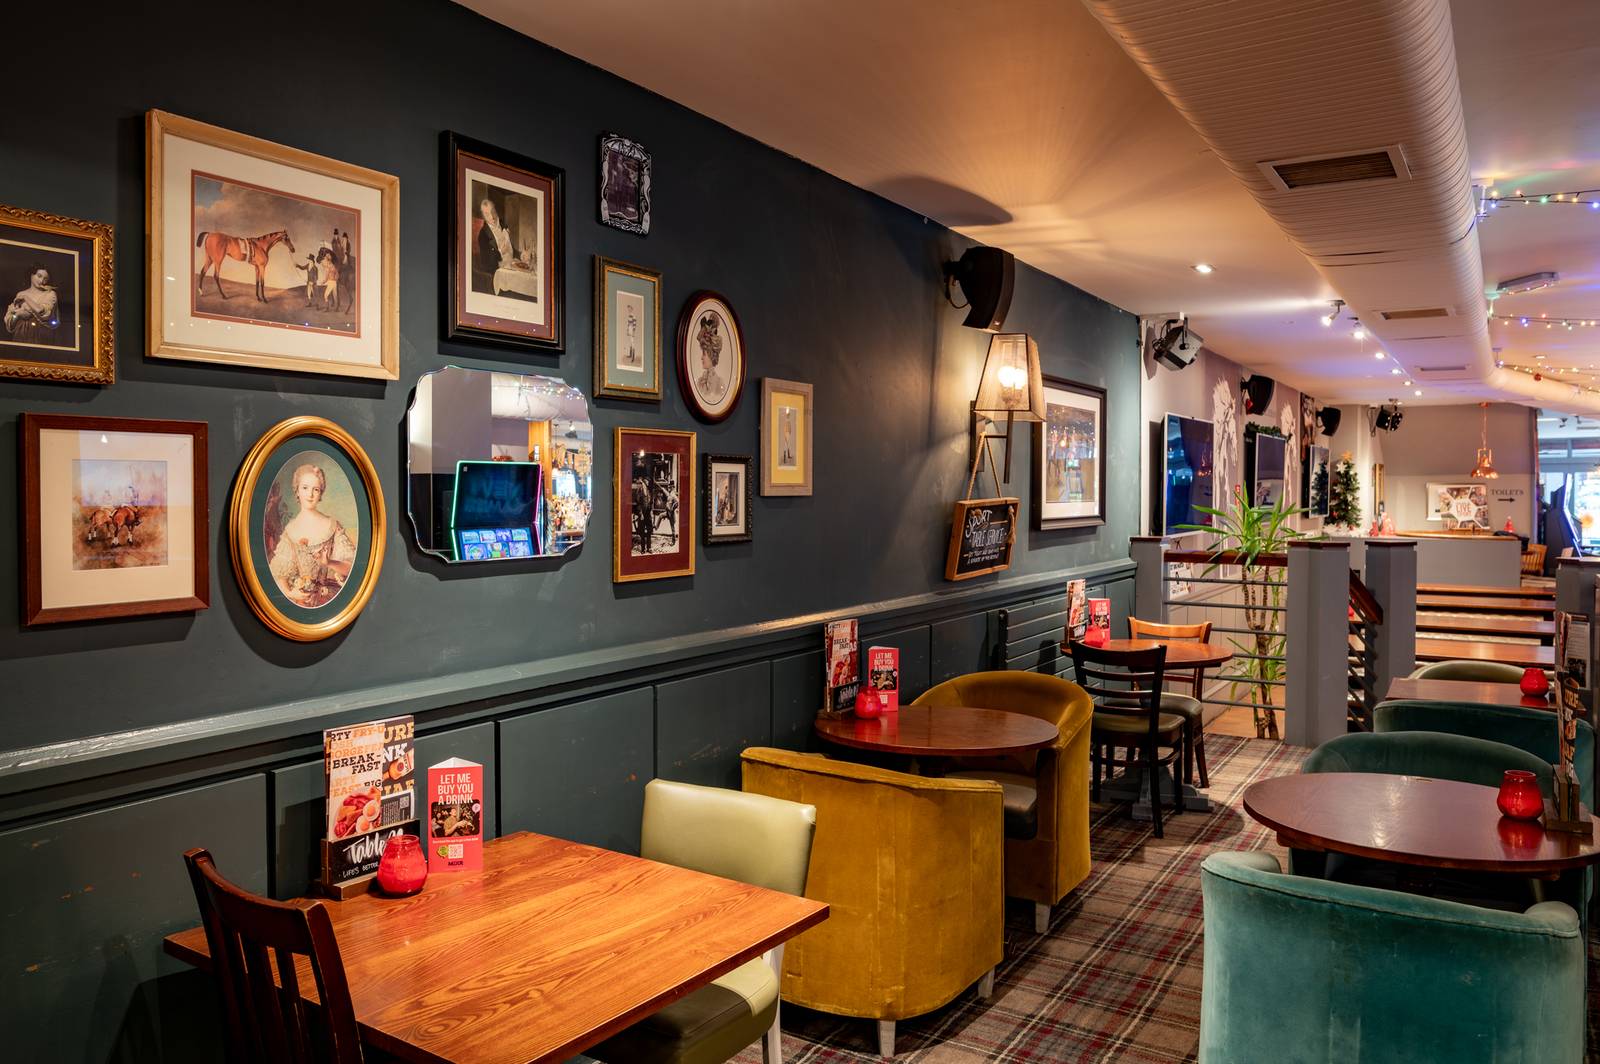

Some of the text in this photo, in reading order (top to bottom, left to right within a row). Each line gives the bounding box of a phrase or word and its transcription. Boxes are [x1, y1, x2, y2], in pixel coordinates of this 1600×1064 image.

[965, 509, 993, 538] SPORT
[333, 752, 382, 770] BREAK-
[352, 761, 381, 775] FAST
[440, 773, 472, 785] LET ME
[438, 783, 474, 795] BUY YOU
[438, 793, 474, 806] A DRINK
[343, 832, 386, 865] Table
